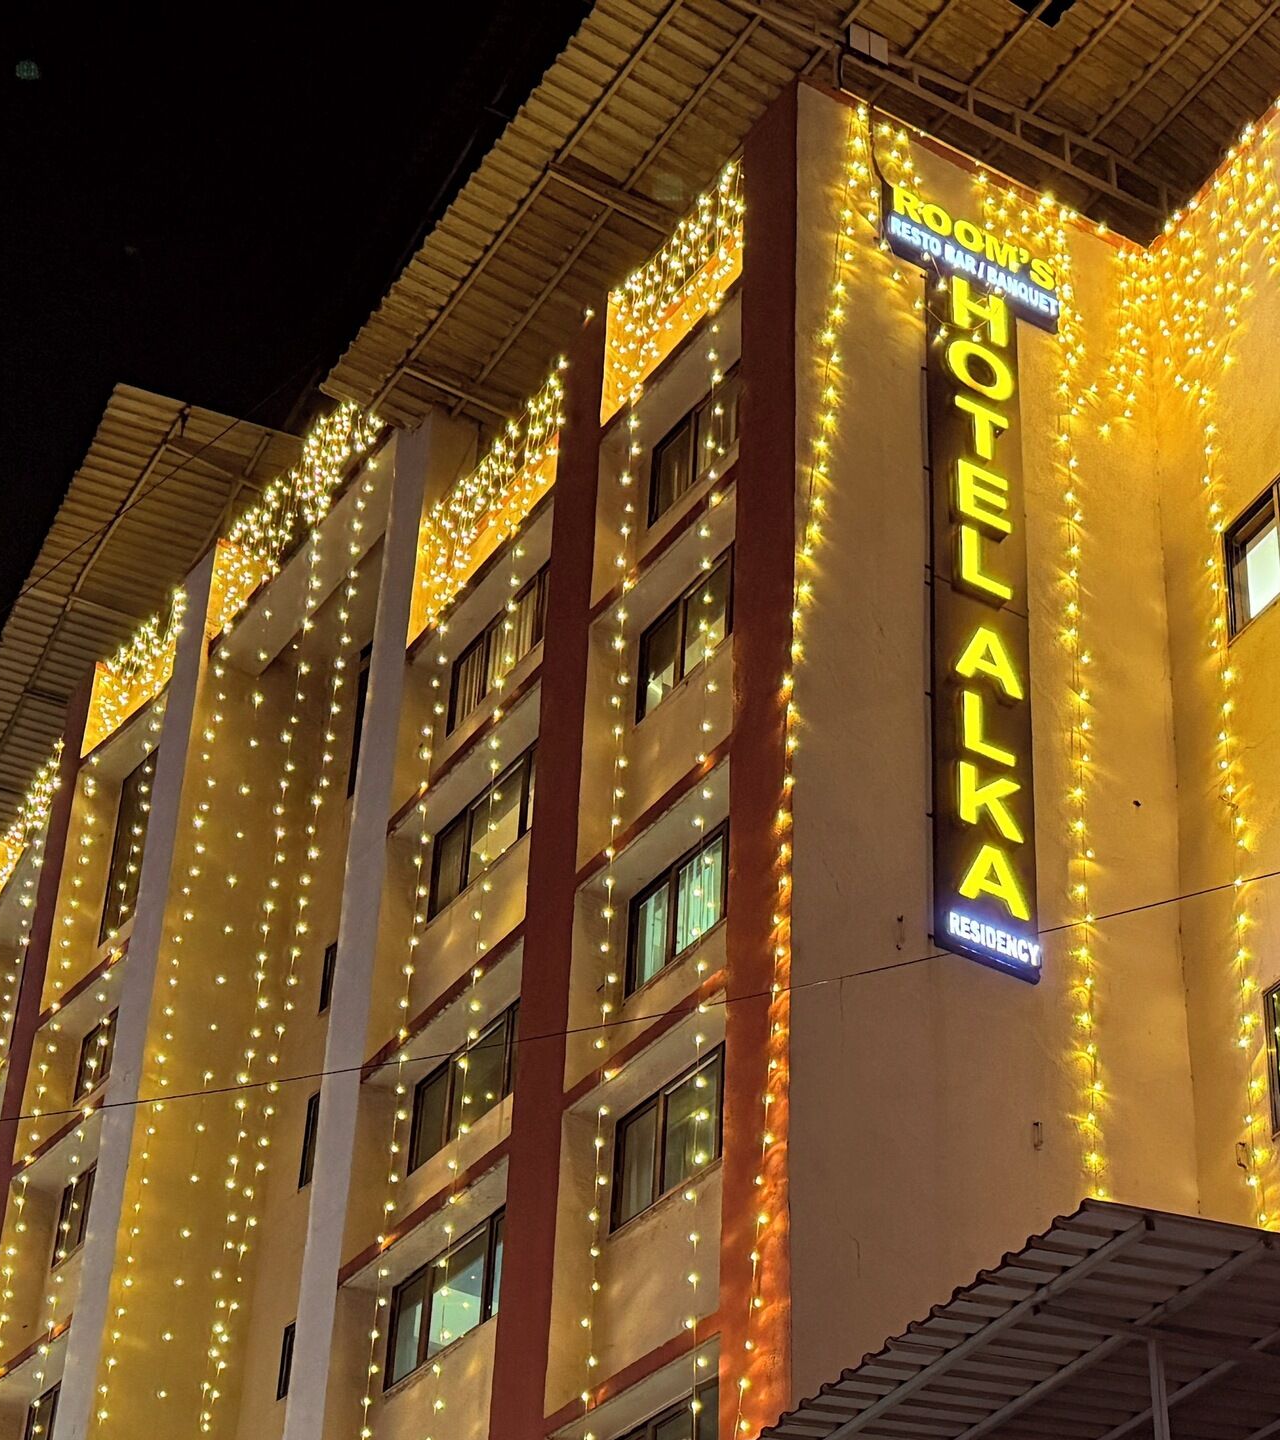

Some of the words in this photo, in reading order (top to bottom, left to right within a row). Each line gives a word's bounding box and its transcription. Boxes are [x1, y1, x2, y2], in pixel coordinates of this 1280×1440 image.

[890, 215, 942, 257] RESTO
[944, 243, 975, 274] BAR
[986, 266, 1061, 316] BANQUET
[891, 183, 1057, 291] ROOM'S
[947, 276, 1015, 601] HOTEL
[955, 626, 1029, 920] ALKA
[948, 911, 1040, 966] RESIDENCY
